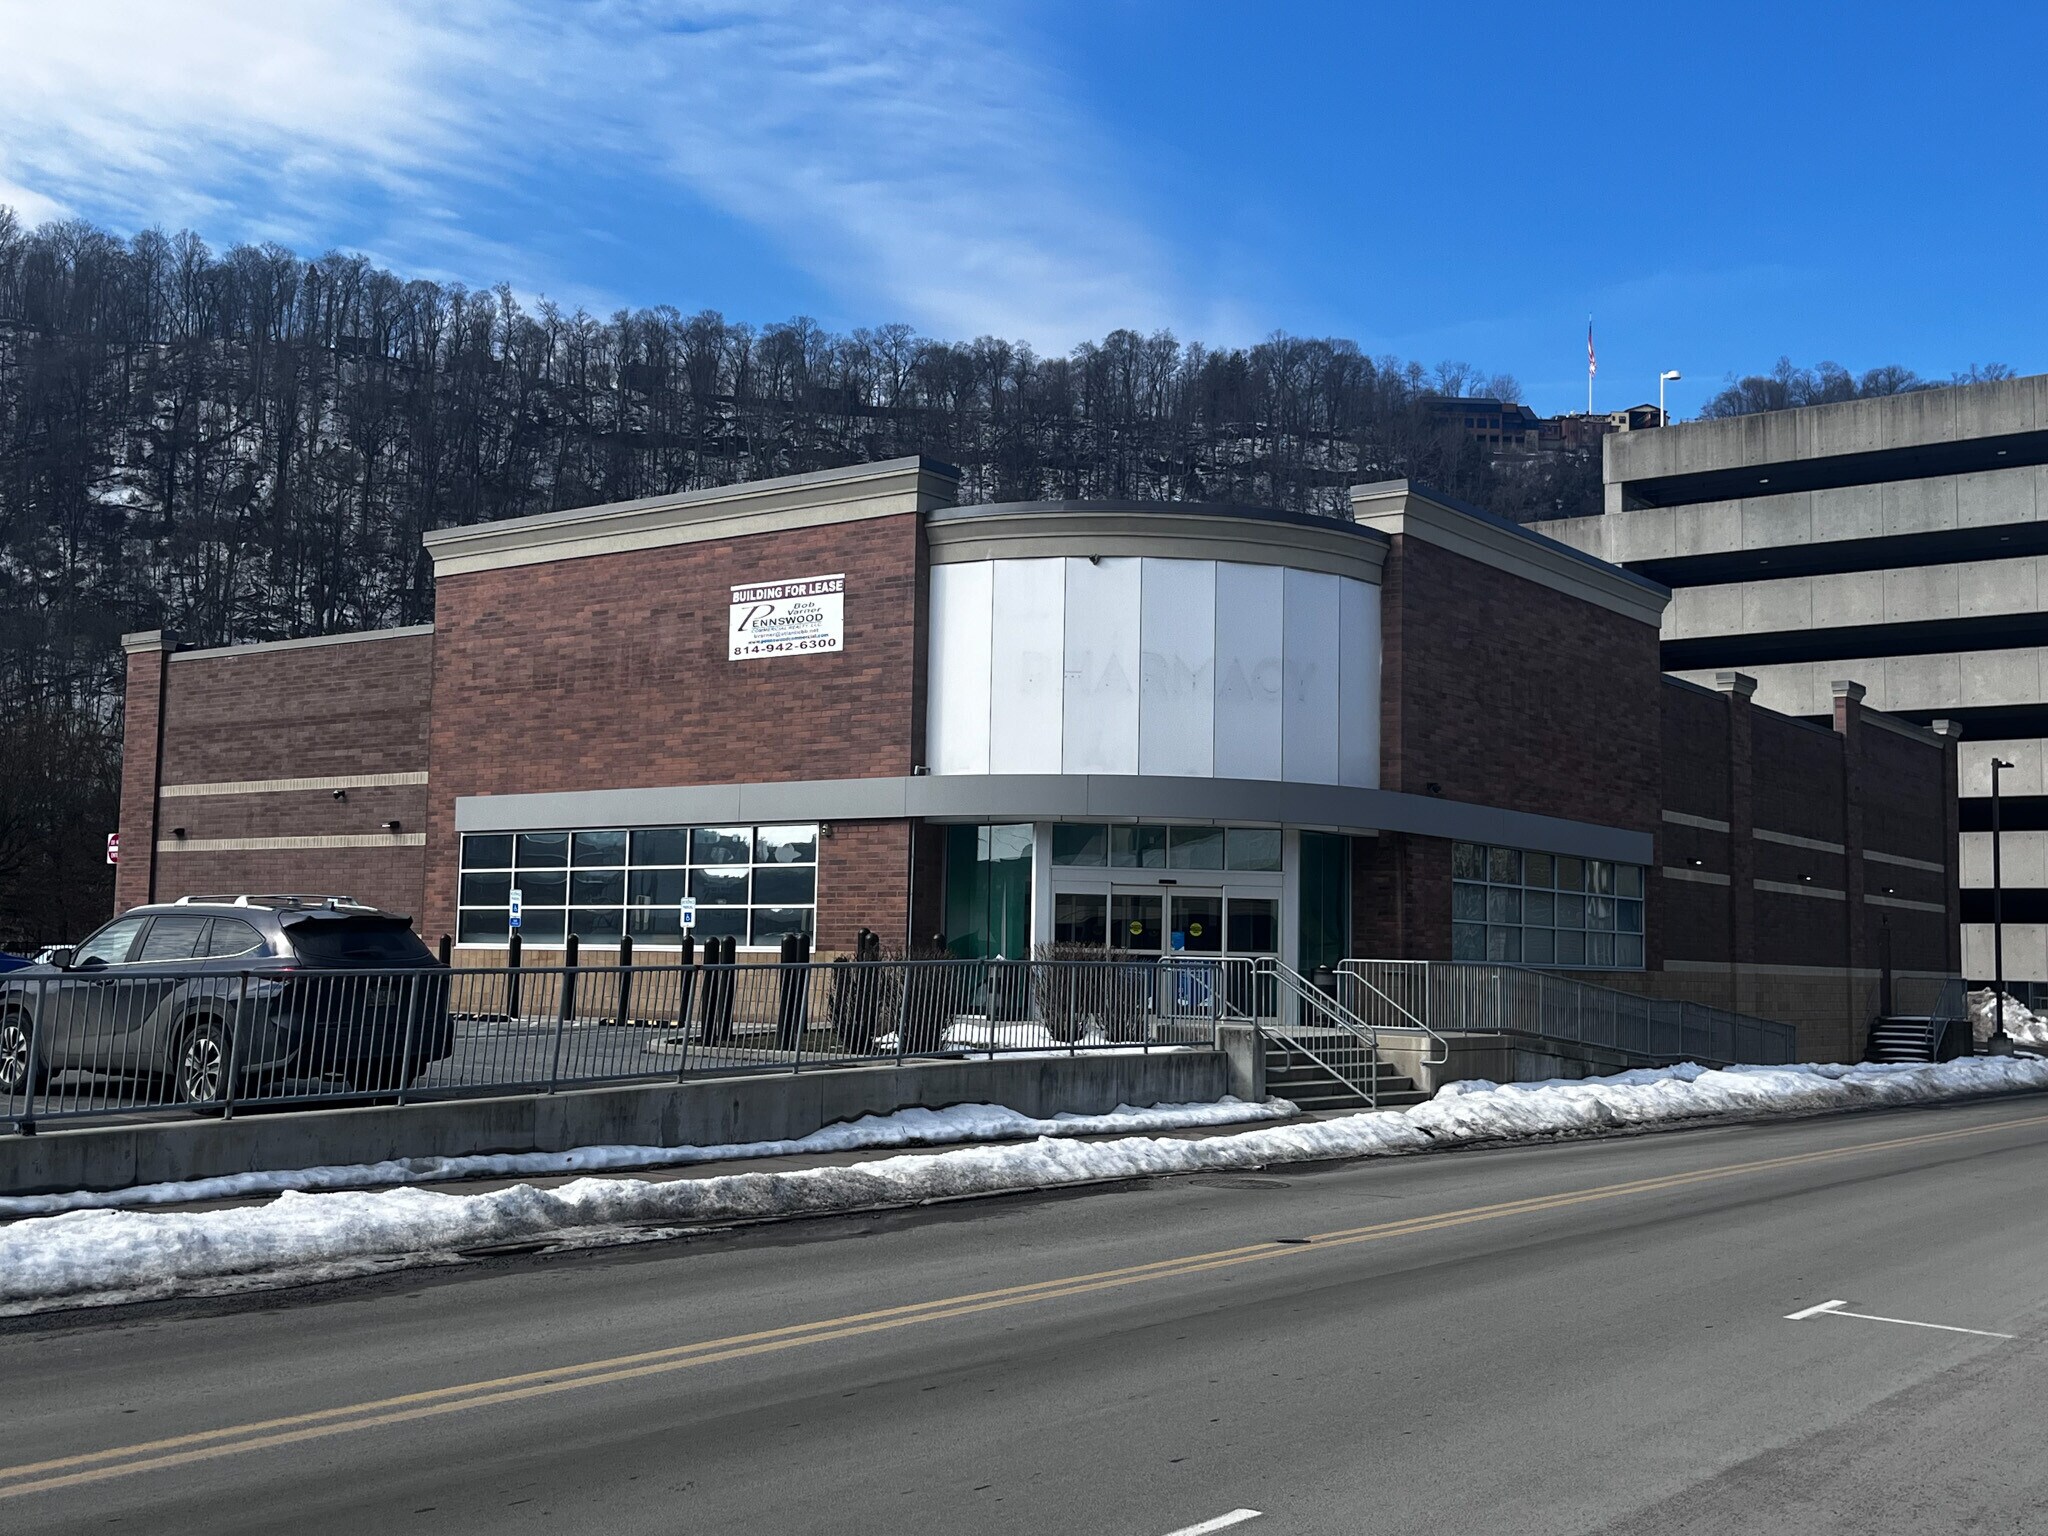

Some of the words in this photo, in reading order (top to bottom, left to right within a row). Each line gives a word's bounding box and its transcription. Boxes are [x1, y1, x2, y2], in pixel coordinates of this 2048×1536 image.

[732, 588, 782, 603] BUILDING
[785, 585, 807, 597] FOR
[809, 580, 844, 594] LEASE
[787, 607, 822, 616] Varner
[794, 601, 815, 609] Bob
[734, 638, 836, 655] 814-942-6300
